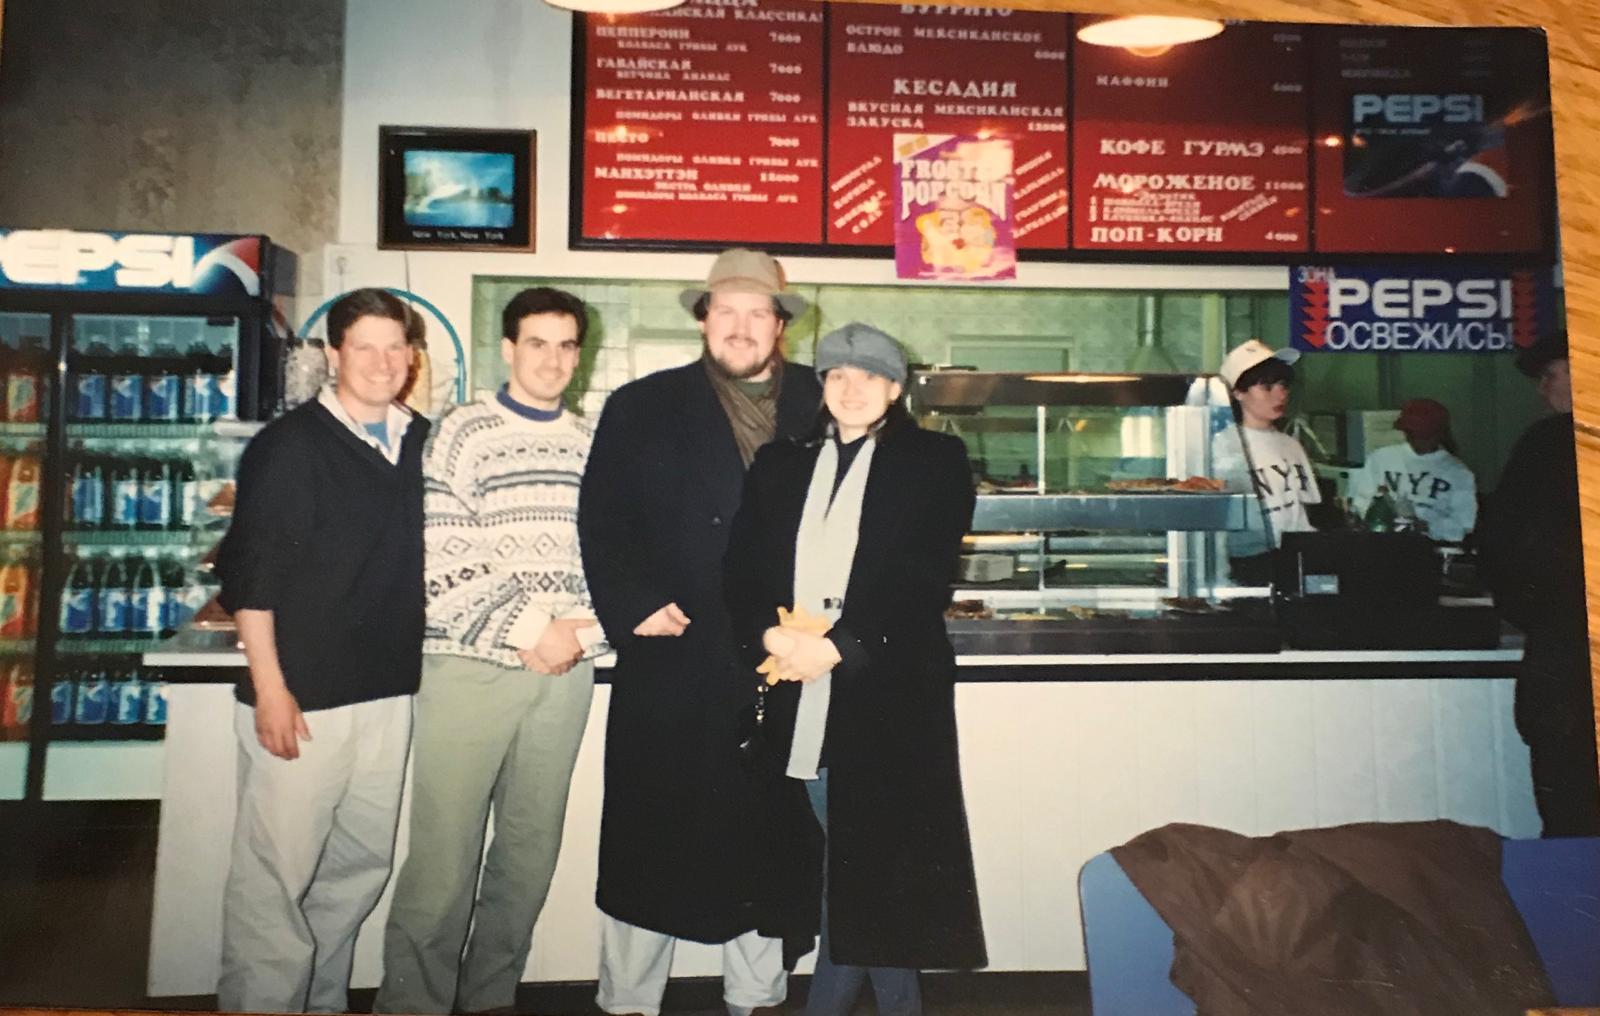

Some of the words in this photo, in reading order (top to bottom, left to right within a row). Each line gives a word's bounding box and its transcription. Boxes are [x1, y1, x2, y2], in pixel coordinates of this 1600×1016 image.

[596, 26, 690, 39] ПЕППЕРОНИ
[846, 25, 901, 37] ОСТРОЕ
[914, 28, 1042, 42] МЕКСИКАНСКОЕ
[847, 42, 904, 55] БЛЮДО
[596, 57, 692, 71] ГАВАЙСКАЯ
[596, 89, 745, 102] ВЕГЕТАРИАНСКАЯ
[893, 79, 1017, 98] КЕСАДИЯ
[848, 102, 924, 115] ВКУСНАЯ
[934, 103, 1064, 117] МЕКСИКАНСКАЯ
[1353, 94, 1484, 123] PEPSI
[847, 117, 924, 129] ЗАКУСКА
[1100, 139, 1165, 155] КОФЕ
[1183, 140, 1265, 157] ГУРМЭ
[594, 167, 698, 180] МАНХЭТТЭН
[1093, 173, 1256, 190] МОРОЖЕНОЕ
[1090, 226, 1223, 242] ПОП-КОРН
[0, 229, 194, 288] EPSI
[1326, 278, 1513, 319] PEPSI
[1325, 320, 1514, 351] ОСВЕЖИСЬ!
[1384, 470, 1452, 499] NYP
